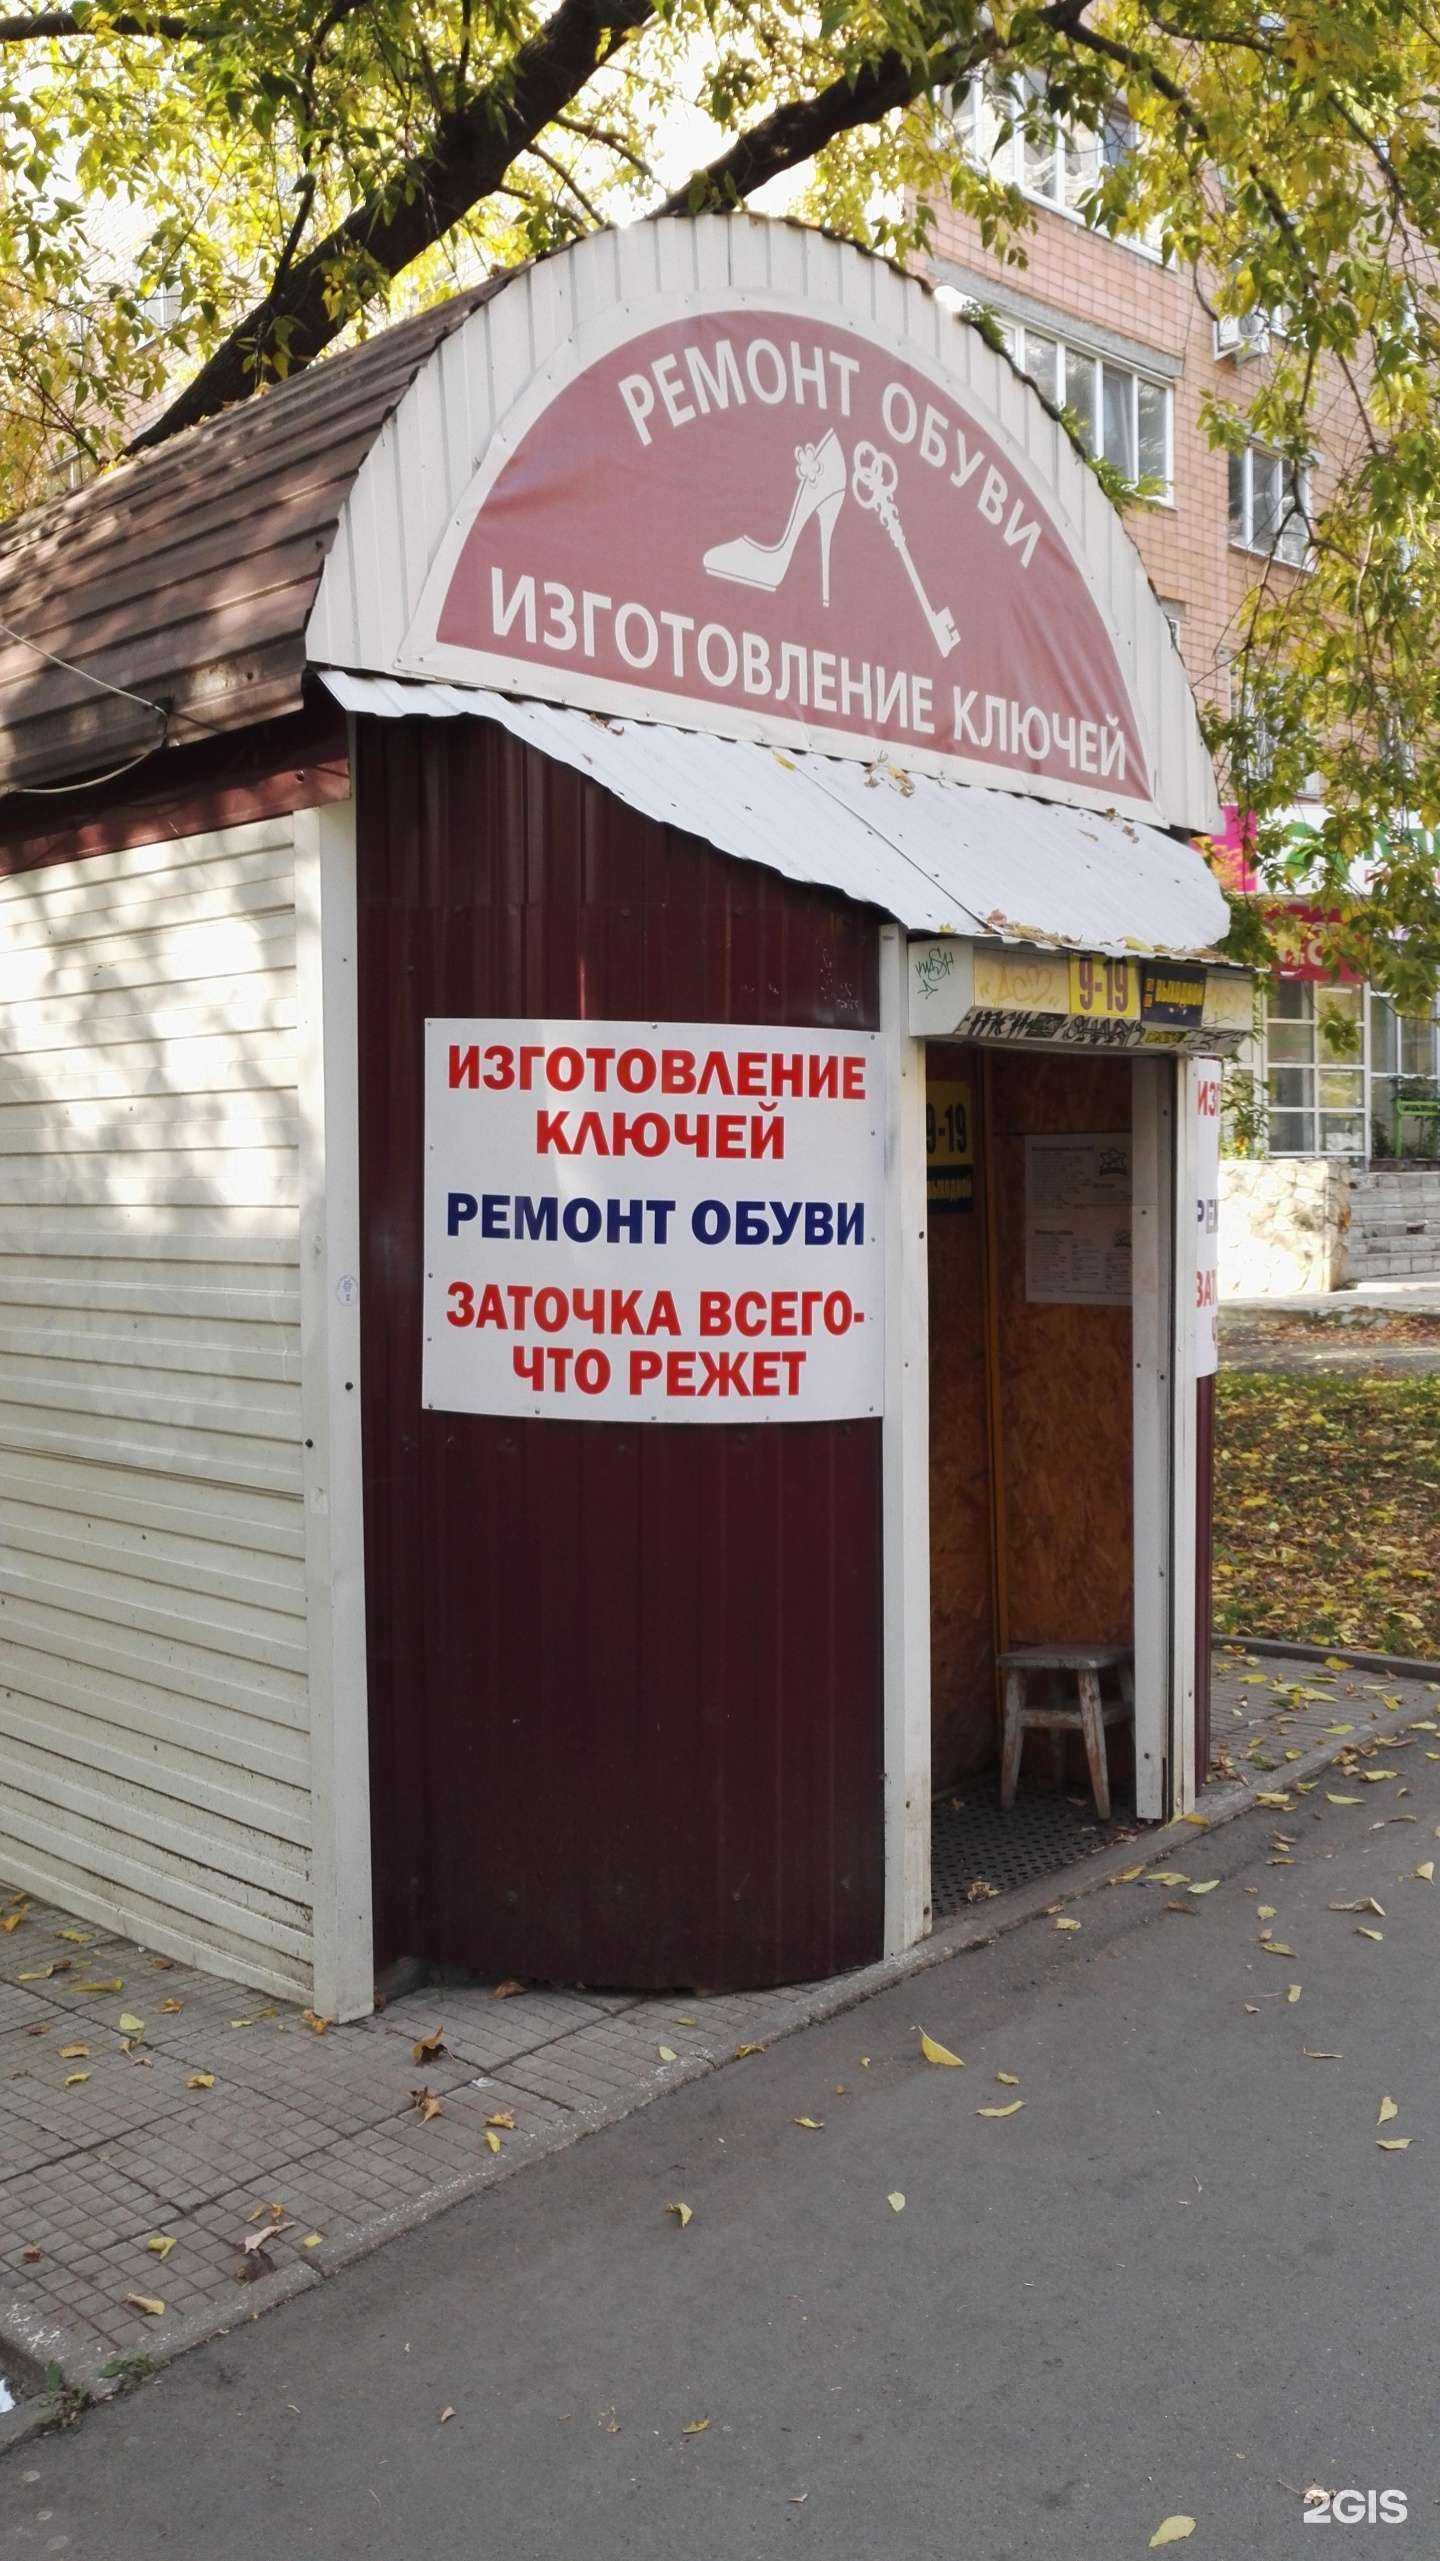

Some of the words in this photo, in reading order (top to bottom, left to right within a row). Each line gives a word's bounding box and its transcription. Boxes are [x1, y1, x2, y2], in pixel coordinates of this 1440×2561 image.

[619, 339, 860, 445] РЕМОНТ
[881, 382, 1043, 568] ОБУВИ
[491, 566, 935, 733] ИЗГОТОВЛЕНИЕ
[952, 685, 1127, 780] КЛЮЧЕЙ
[1079, 957, 1129, 1012] 9-19
[448, 1044, 866, 1100] ИЗГОТОВЛЕНИЕ
[536, 1101, 785, 1159] КЛЮЧЕЙ
[447, 1192, 676, 1246] РЕМОНТ
[691, 1200, 865, 1247] ОБУВИ
[447, 1281, 680, 1336] ЗАТОЧКА
[700, 1291, 864, 1337] ВСЕГО-
[512, 1346, 611, 1395] ЧТО
[629, 1350, 806, 1397] РЕЖЕТ
